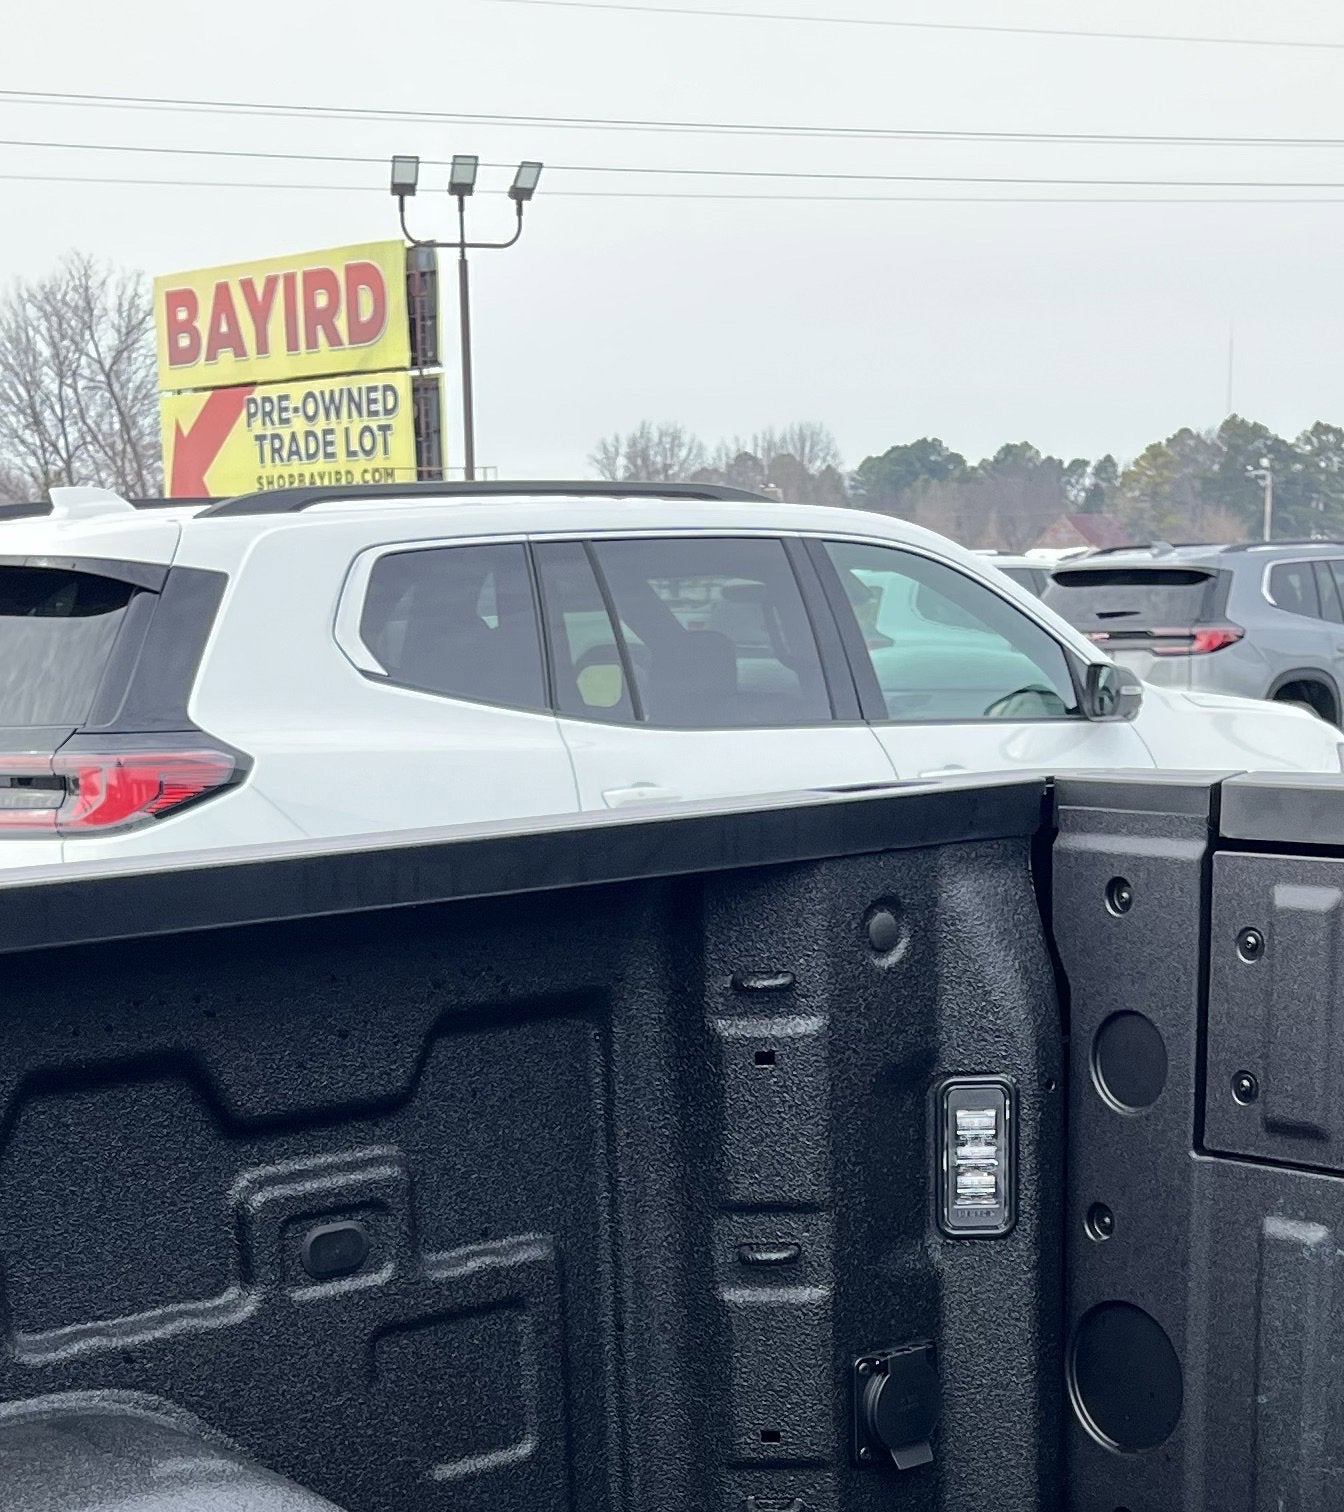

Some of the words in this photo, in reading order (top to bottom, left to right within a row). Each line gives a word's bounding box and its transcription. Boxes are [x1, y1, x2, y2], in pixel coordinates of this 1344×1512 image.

[164, 261, 387, 367] BAYIRD
[246, 384, 399, 428] PRE-OWNED
[254, 427, 337, 464] TRADE
[346, 424, 393, 458] LOT
[256, 467, 395, 490] SHOPBAYIRD.COM
